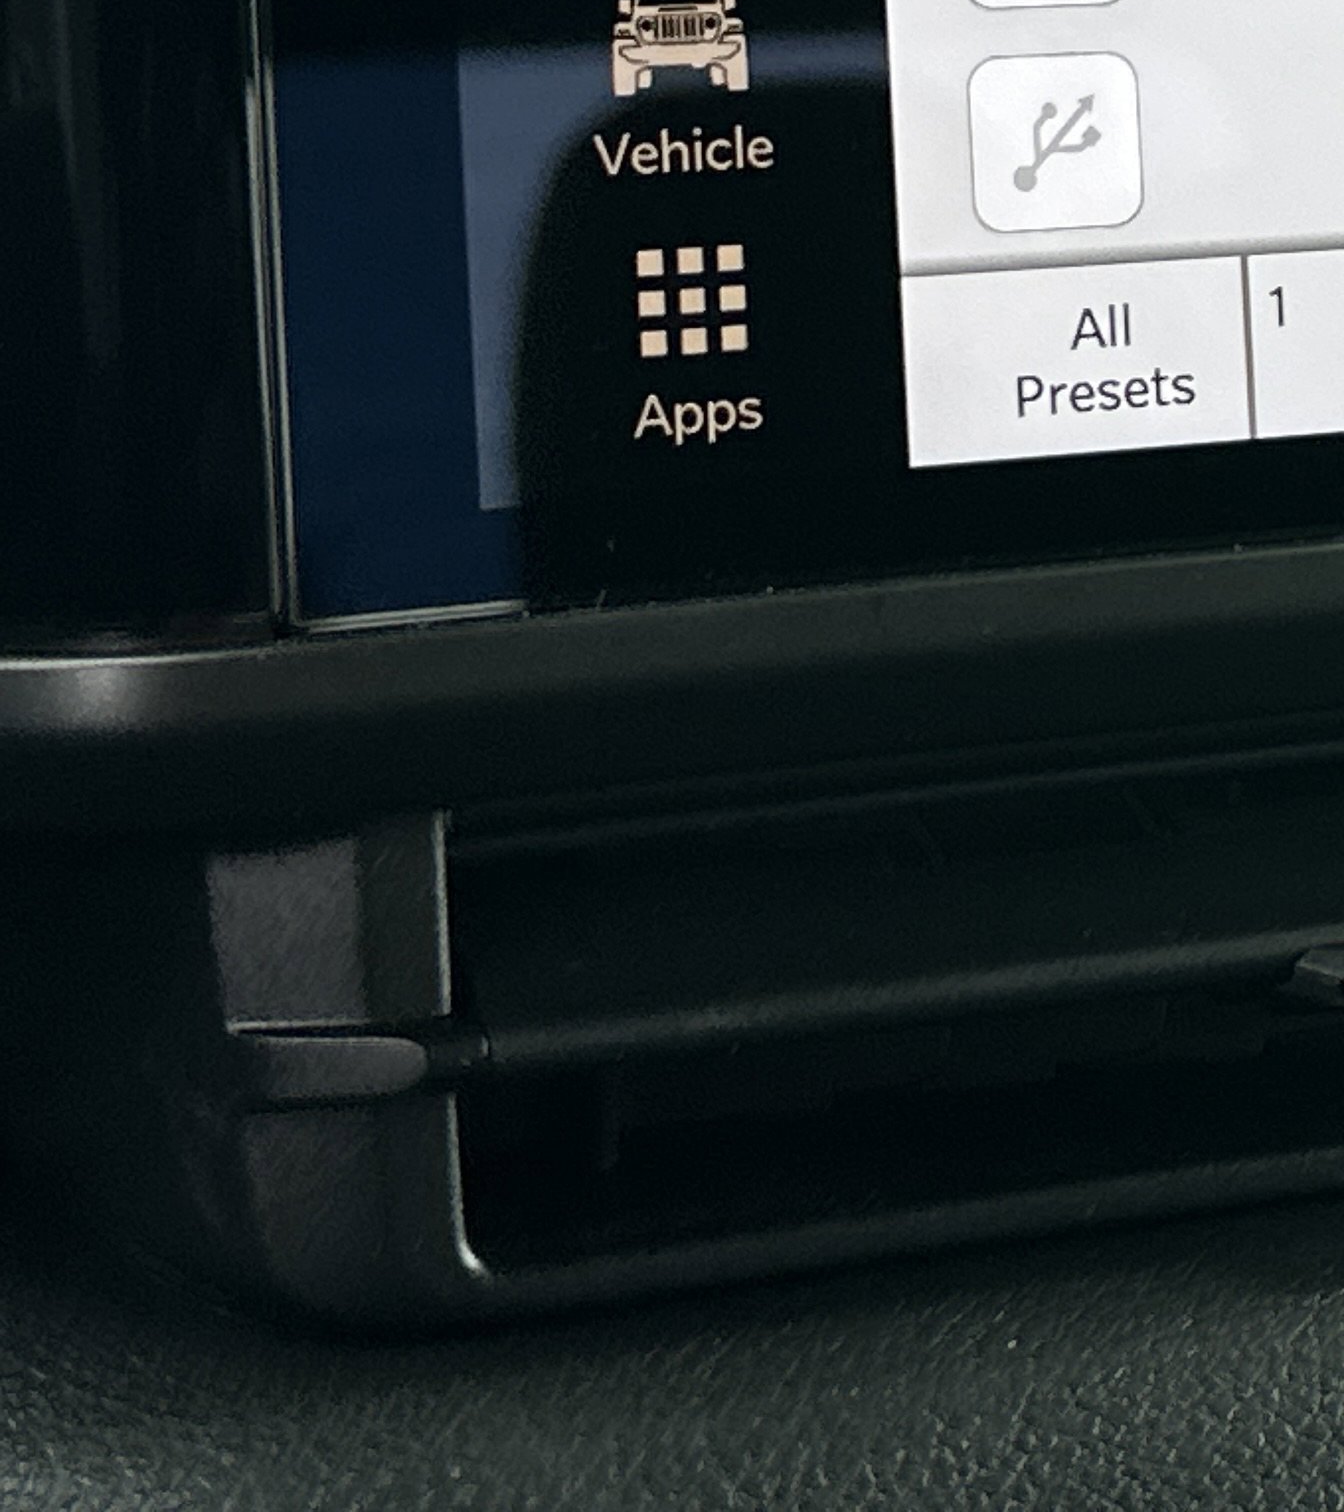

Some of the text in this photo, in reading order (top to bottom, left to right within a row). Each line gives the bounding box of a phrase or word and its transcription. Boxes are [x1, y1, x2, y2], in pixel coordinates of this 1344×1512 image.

[593, 124, 774, 175] Vehicle
[1070, 303, 1131, 351] All
[1269, 286, 1284, 327] 1
[1016, 367, 1196, 418] Presets
[634, 394, 764, 446] Apps
